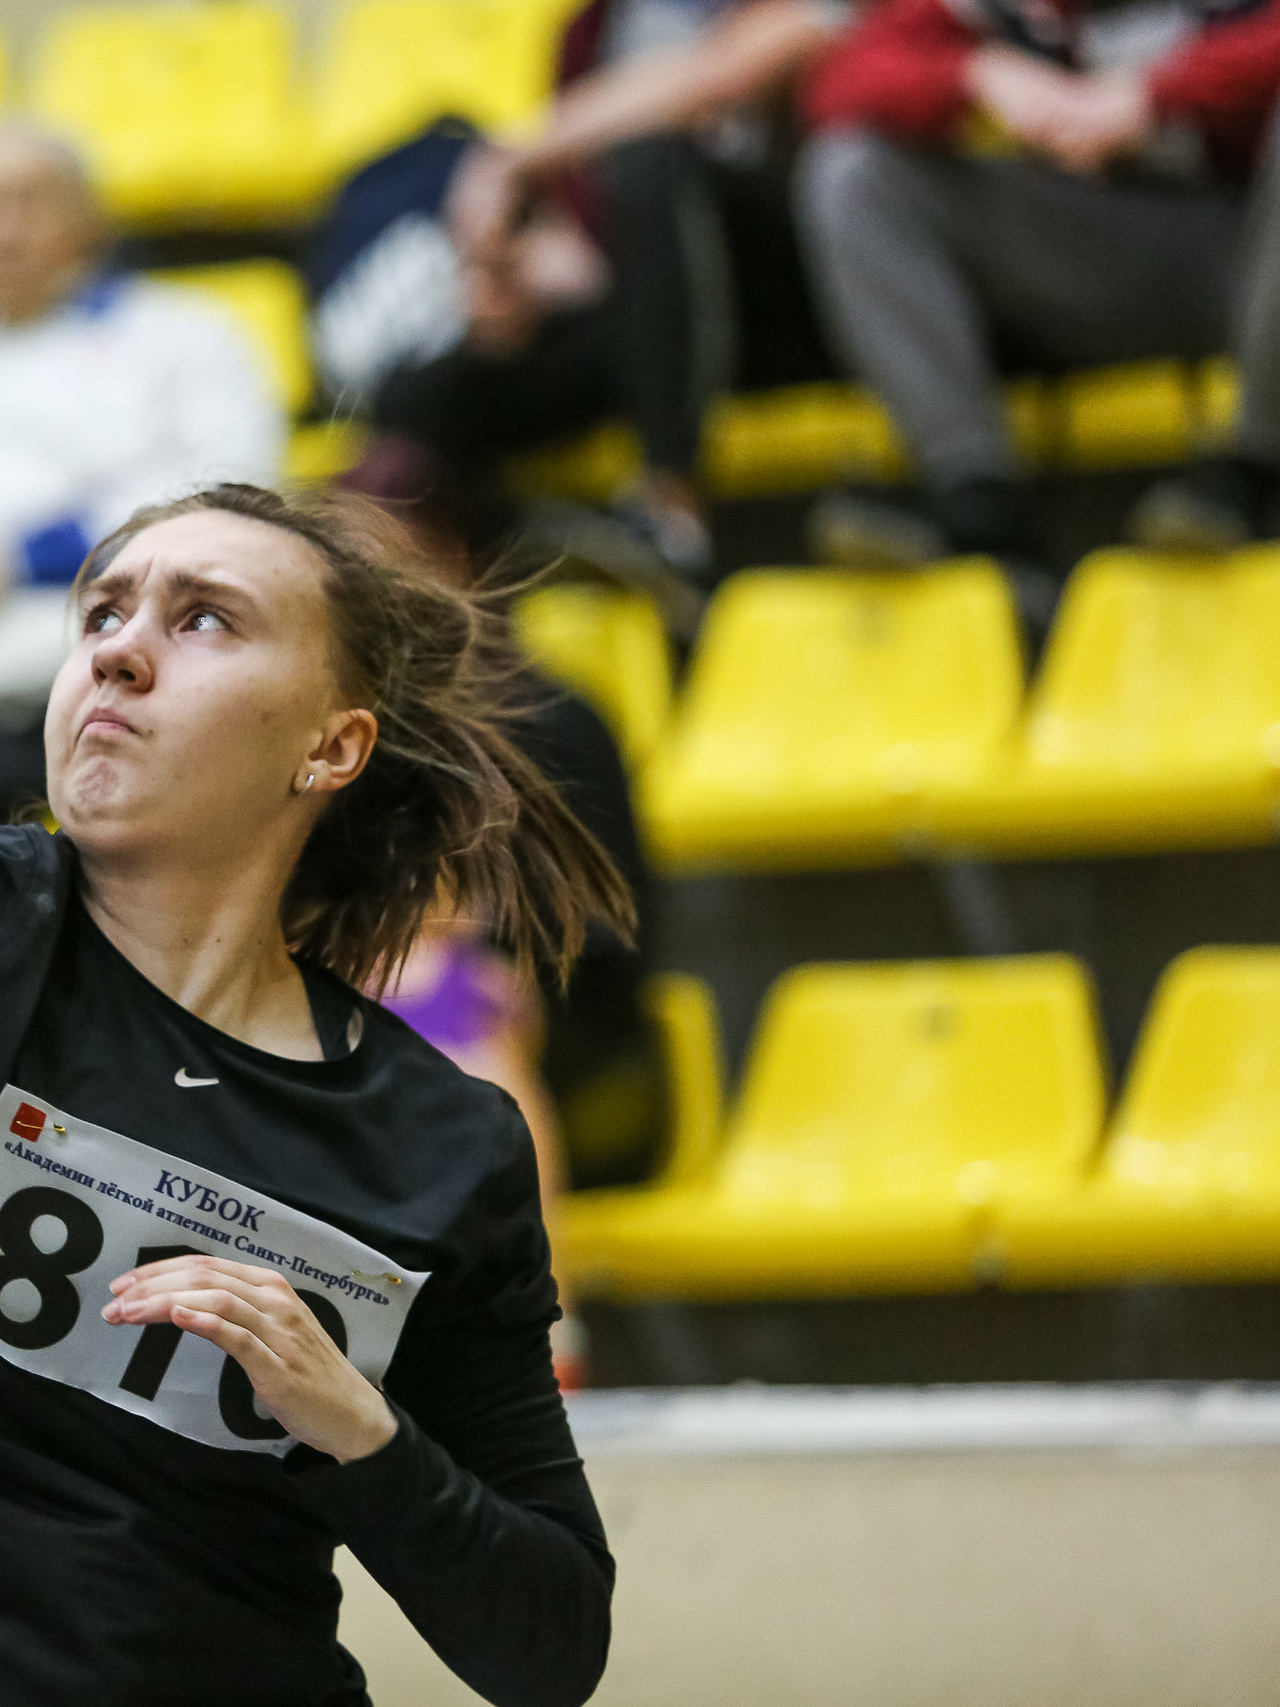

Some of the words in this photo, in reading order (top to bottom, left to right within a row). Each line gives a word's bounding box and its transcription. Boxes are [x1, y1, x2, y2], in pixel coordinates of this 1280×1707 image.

[4, 1140, 95, 1189] «Академии
[96, 1181, 155, 1214] лёгкой
[156, 1206, 232, 1246] атлетики
[233, 1234, 391, 1306] Санкт-Петербурга»
[154, 1169, 266, 1233] КУБОК
